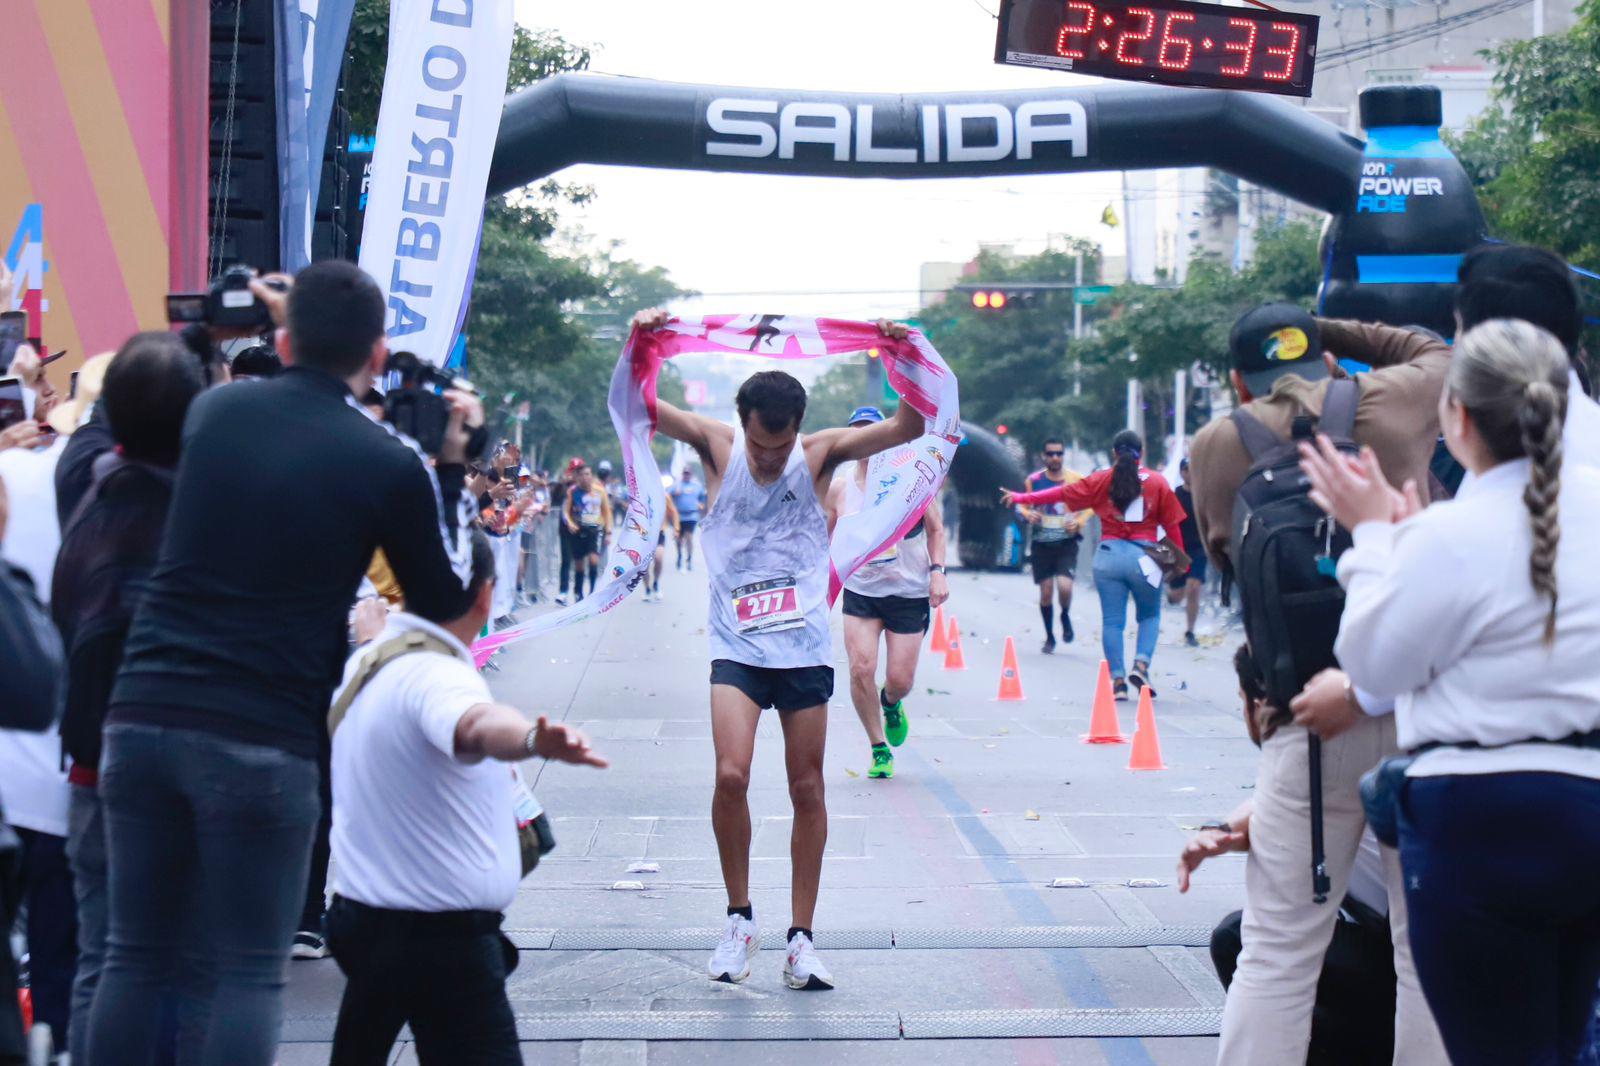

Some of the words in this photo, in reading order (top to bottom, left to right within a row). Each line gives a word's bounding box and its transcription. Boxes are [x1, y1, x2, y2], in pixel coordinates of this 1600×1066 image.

[705, 98, 1088, 163] SALIDA
[1358, 177, 1444, 196] POWER
[747, 591, 785, 617] 277
